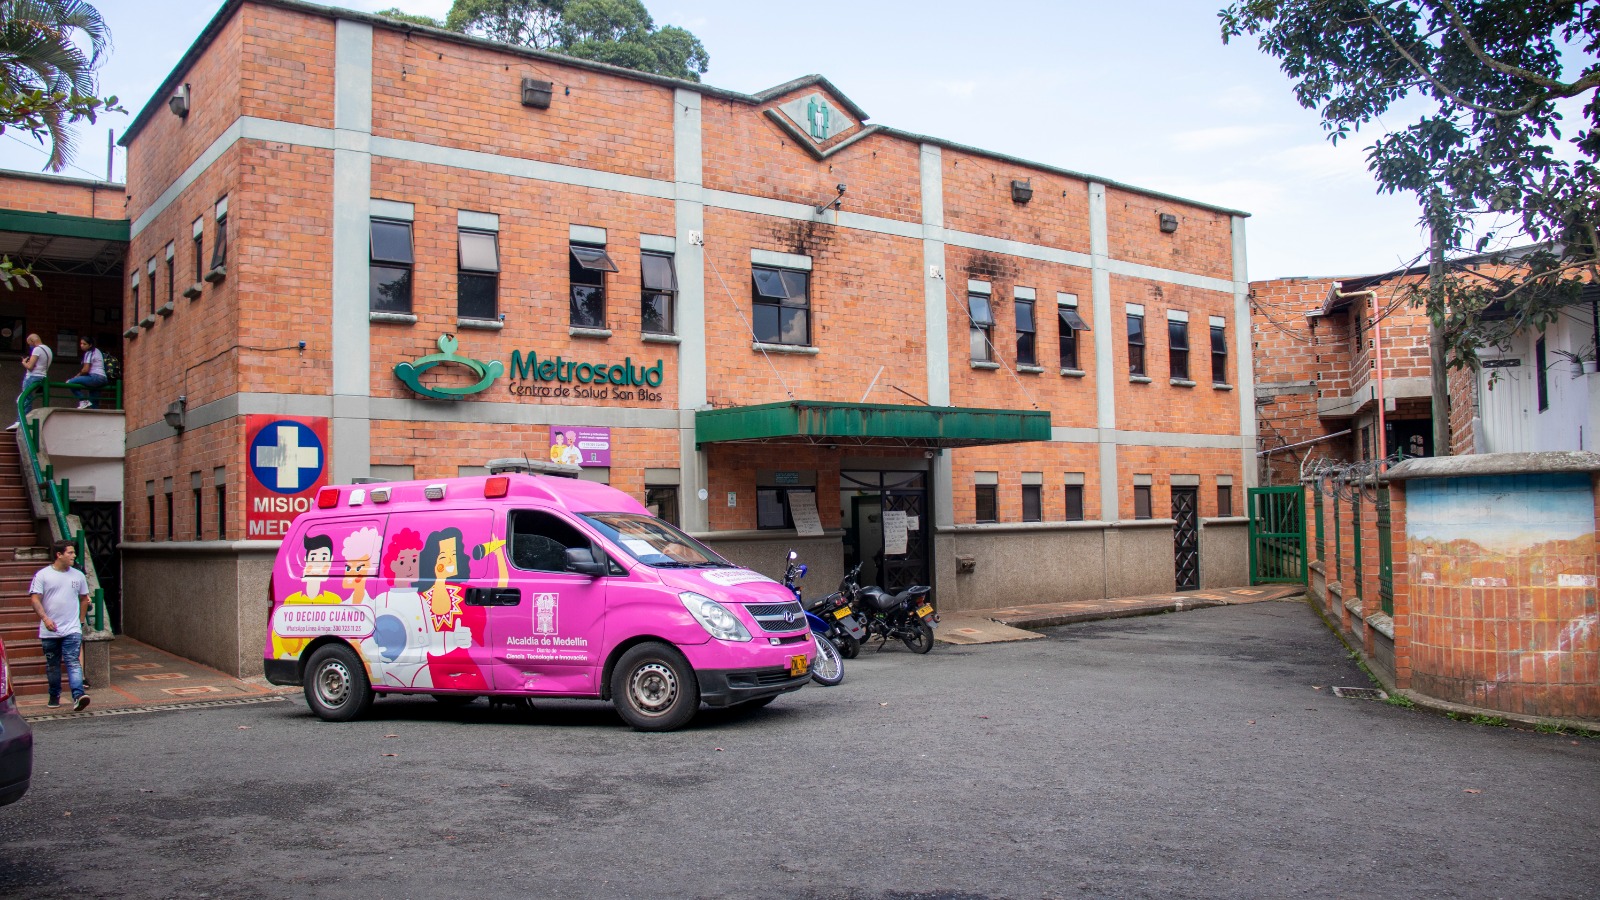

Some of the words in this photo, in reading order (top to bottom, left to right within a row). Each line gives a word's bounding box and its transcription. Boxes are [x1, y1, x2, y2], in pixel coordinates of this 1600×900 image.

[510, 349, 663, 387] Metrosalud
[508, 381, 550, 396] Centro
[553, 384, 570, 397] de
[574, 385, 608, 399] Salud
[612, 386, 634, 401] San
[638, 388, 663, 402] Blas
[283, 611, 294, 622] YO
[296, 611, 327, 622] DECIDO
[329, 608, 366, 622] CUÁNDO
[507, 637, 539, 645] Alcaldía
[541, 637, 551, 645] de
[553, 637, 587, 646] Medellín
